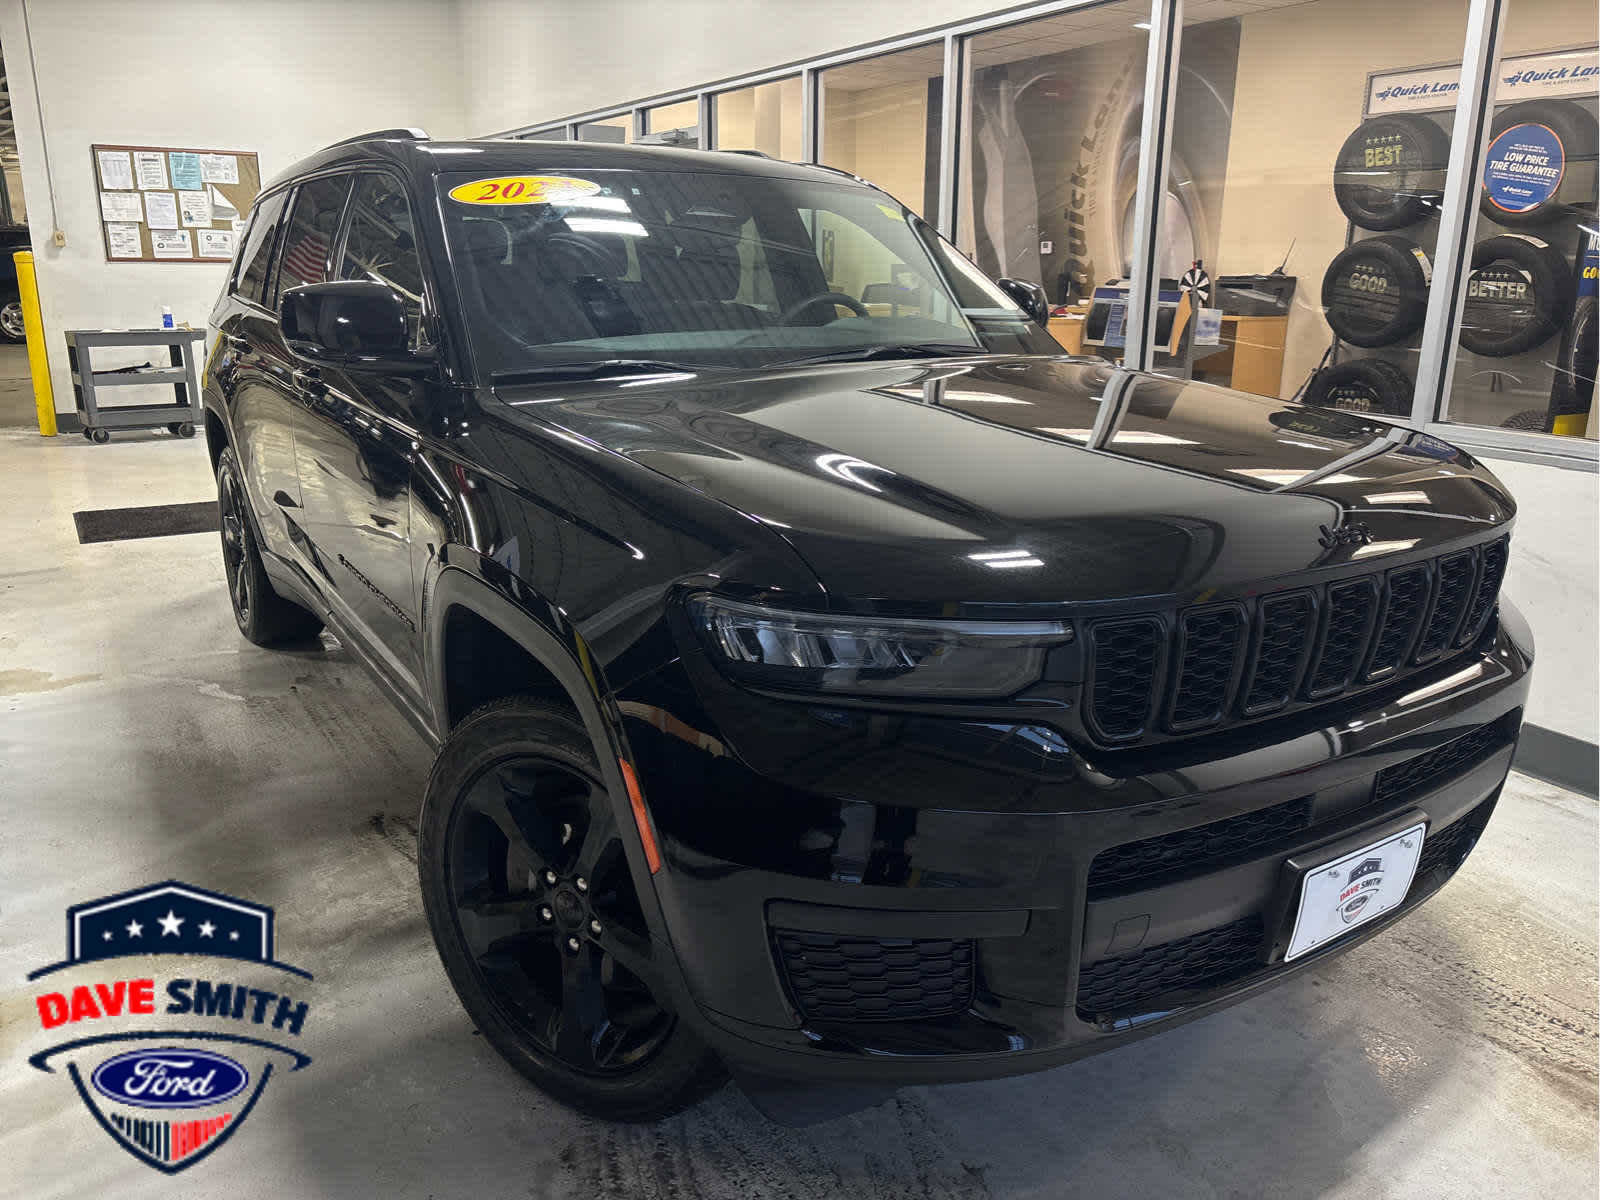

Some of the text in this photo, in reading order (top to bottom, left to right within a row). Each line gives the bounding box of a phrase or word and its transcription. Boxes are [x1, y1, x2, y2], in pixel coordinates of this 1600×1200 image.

[1521, 67, 1569, 84] Quick
[1391, 83, 1430, 98] Quick
[1431, 81, 1460, 93] Lan
[1364, 144, 1403, 169] BEST
[1504, 151, 1550, 166] LOW PRICE
[1489, 160, 1560, 178] TIRE GUARANTEE
[1349, 272, 1388, 295] GOOD
[1468, 280, 1528, 300] BETTER
[1340, 883, 1360, 902] DAVE
